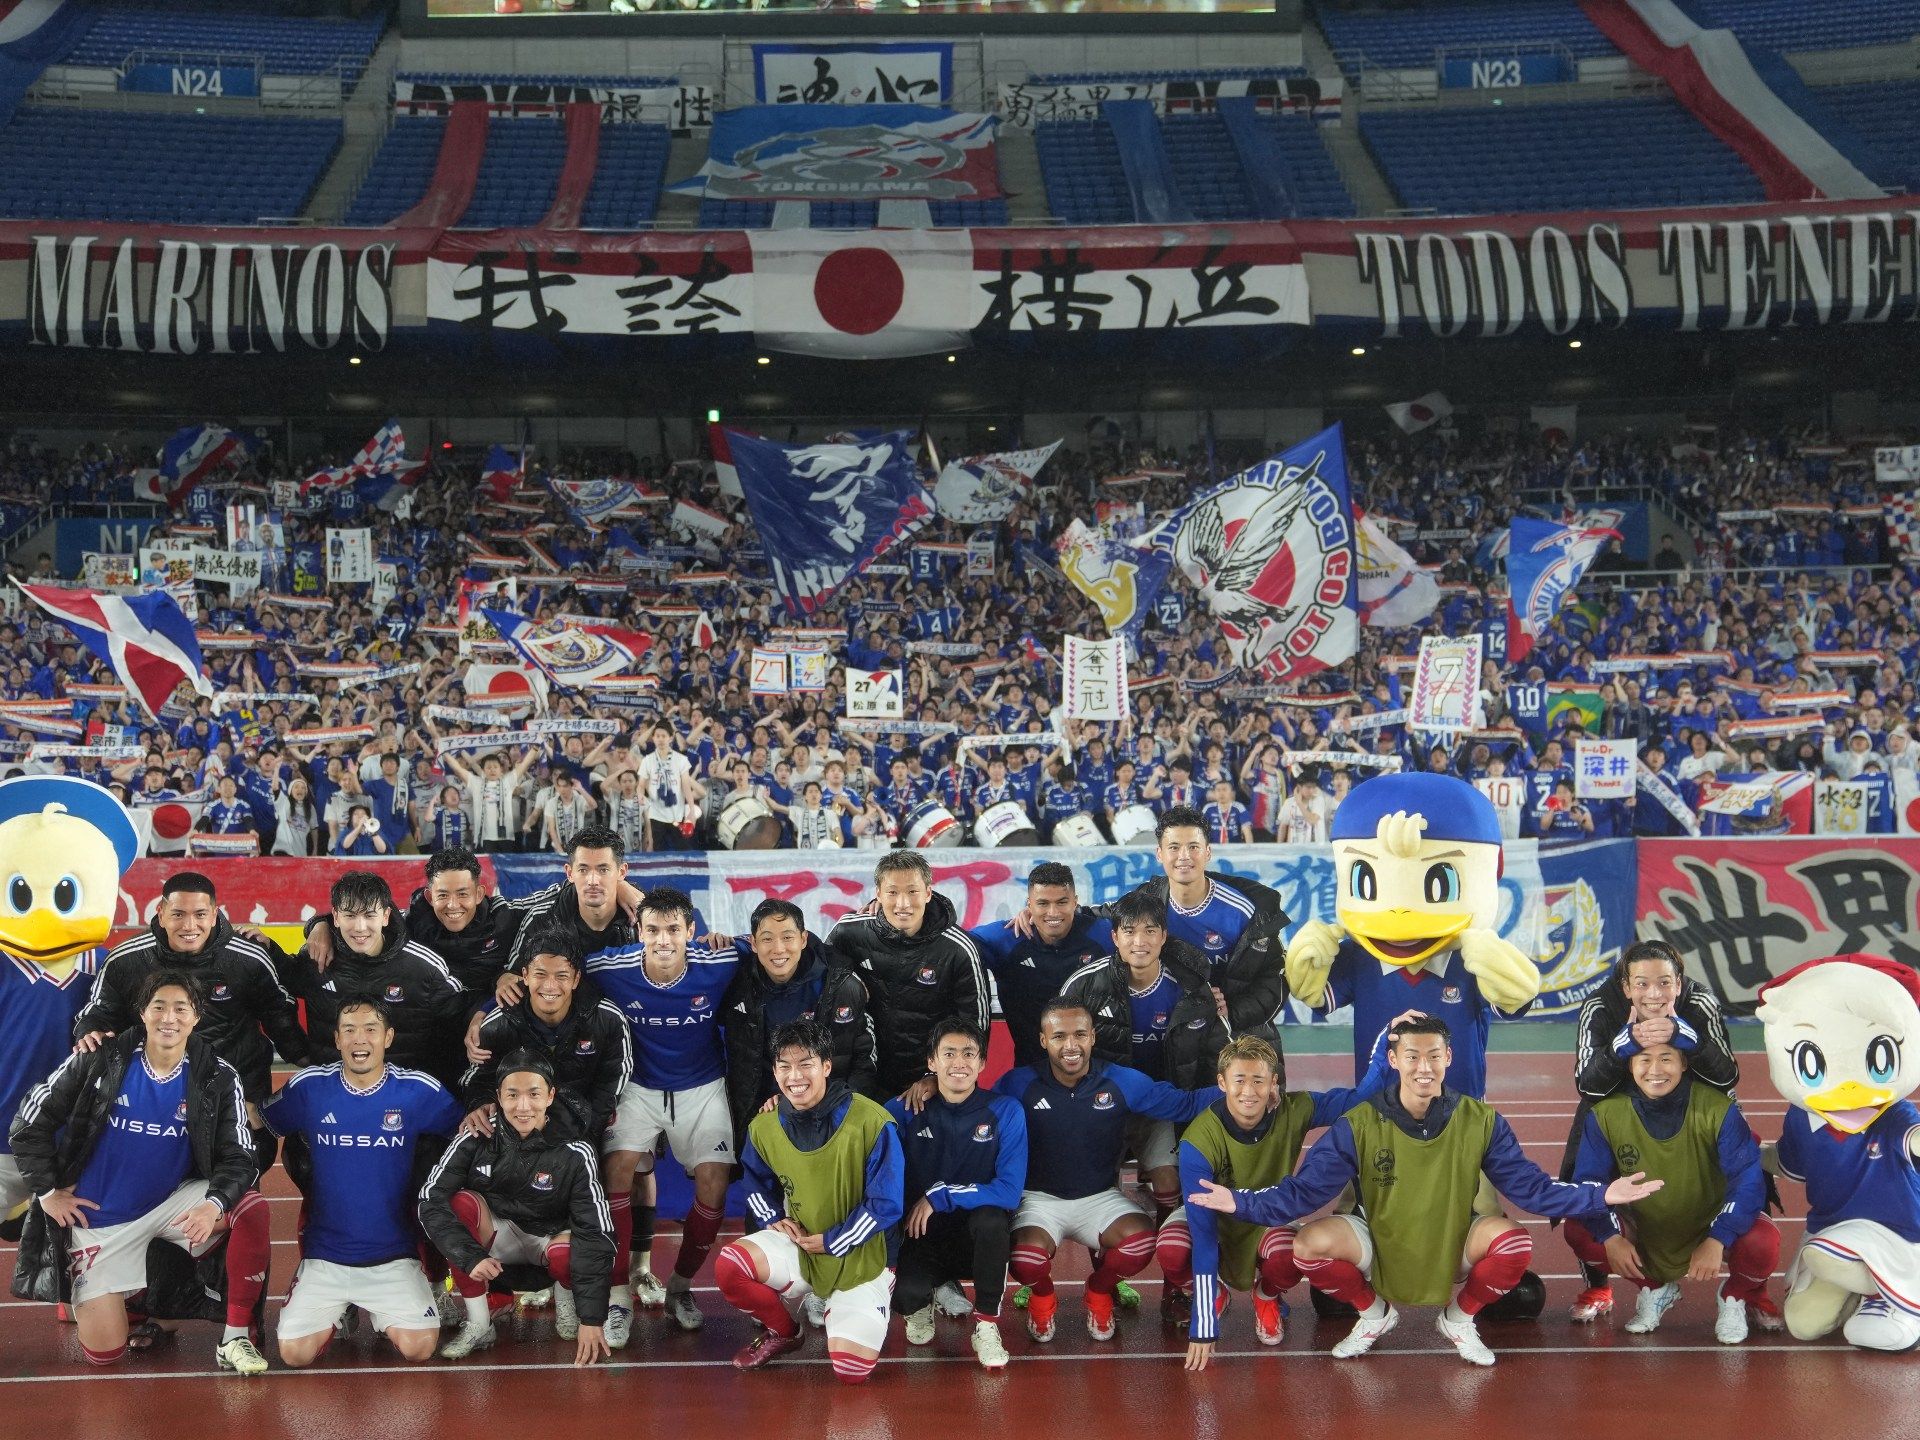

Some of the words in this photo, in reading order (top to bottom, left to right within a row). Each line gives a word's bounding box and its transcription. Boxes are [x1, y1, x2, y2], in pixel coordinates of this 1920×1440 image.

[171, 69, 224, 98] N24
[1471, 60, 1522, 88] N23
[753, 181, 930, 193] YOKOHAMA
[1355, 221, 1631, 338] TODOS
[27, 235, 396, 356] MARINOS
[194, 554, 260, 578] 横浜優勝
[1160, 605, 1182, 624] 23
[387, 622, 406, 641] 77
[1487, 632, 1506, 652] 14
[754, 658, 785, 684] 27
[854, 681, 871, 693] 27
[1432, 657, 1463, 717] 7
[853, 702, 877, 710] 松原
[886, 702, 897, 711] 健
[1516, 687, 1540, 711] 10
[108, 726, 121, 734] 23
[534, 721, 617, 733] アジアを勝ち獲ろう
[91, 735, 117, 747] 宮市
[447, 732, 540, 747] アジアを勝ち獲ろう
[1584, 756, 1630, 777] 深井
[1487, 782, 1511, 807] 10
[1818, 785, 1863, 810] 水沼
[627, 1011, 713, 1026] NISSAN
[107, 1116, 189, 1137] NISSAN
[317, 1134, 405, 1148] NISSAN
